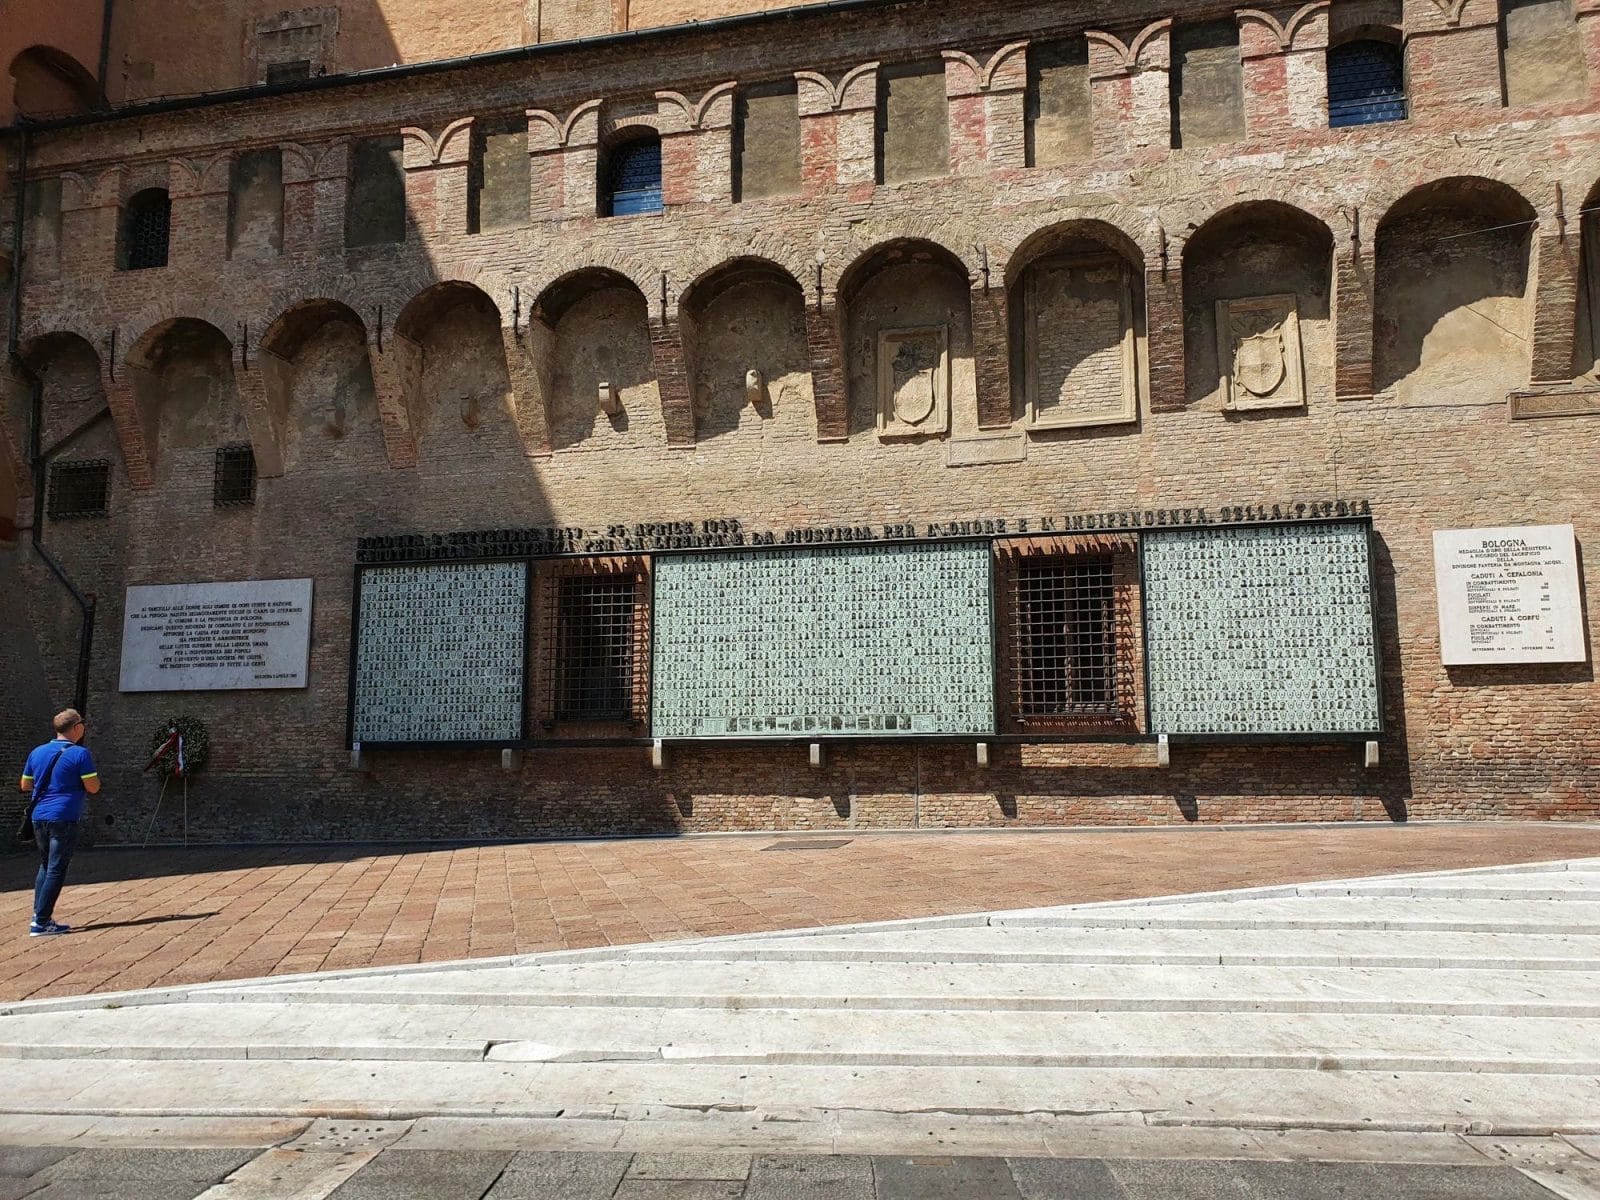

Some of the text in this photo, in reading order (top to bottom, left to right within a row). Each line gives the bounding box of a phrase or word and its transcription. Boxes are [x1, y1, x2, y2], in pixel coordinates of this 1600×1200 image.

[752, 530, 774, 546] LA
[883, 523, 916, 539] PER
[1018, 517, 1028, 532] E
[1482, 539, 1526, 549] BOLOGNA
[1471, 572, 1495, 580] CADUTI
[1506, 570, 1544, 578] CEFALONIA
